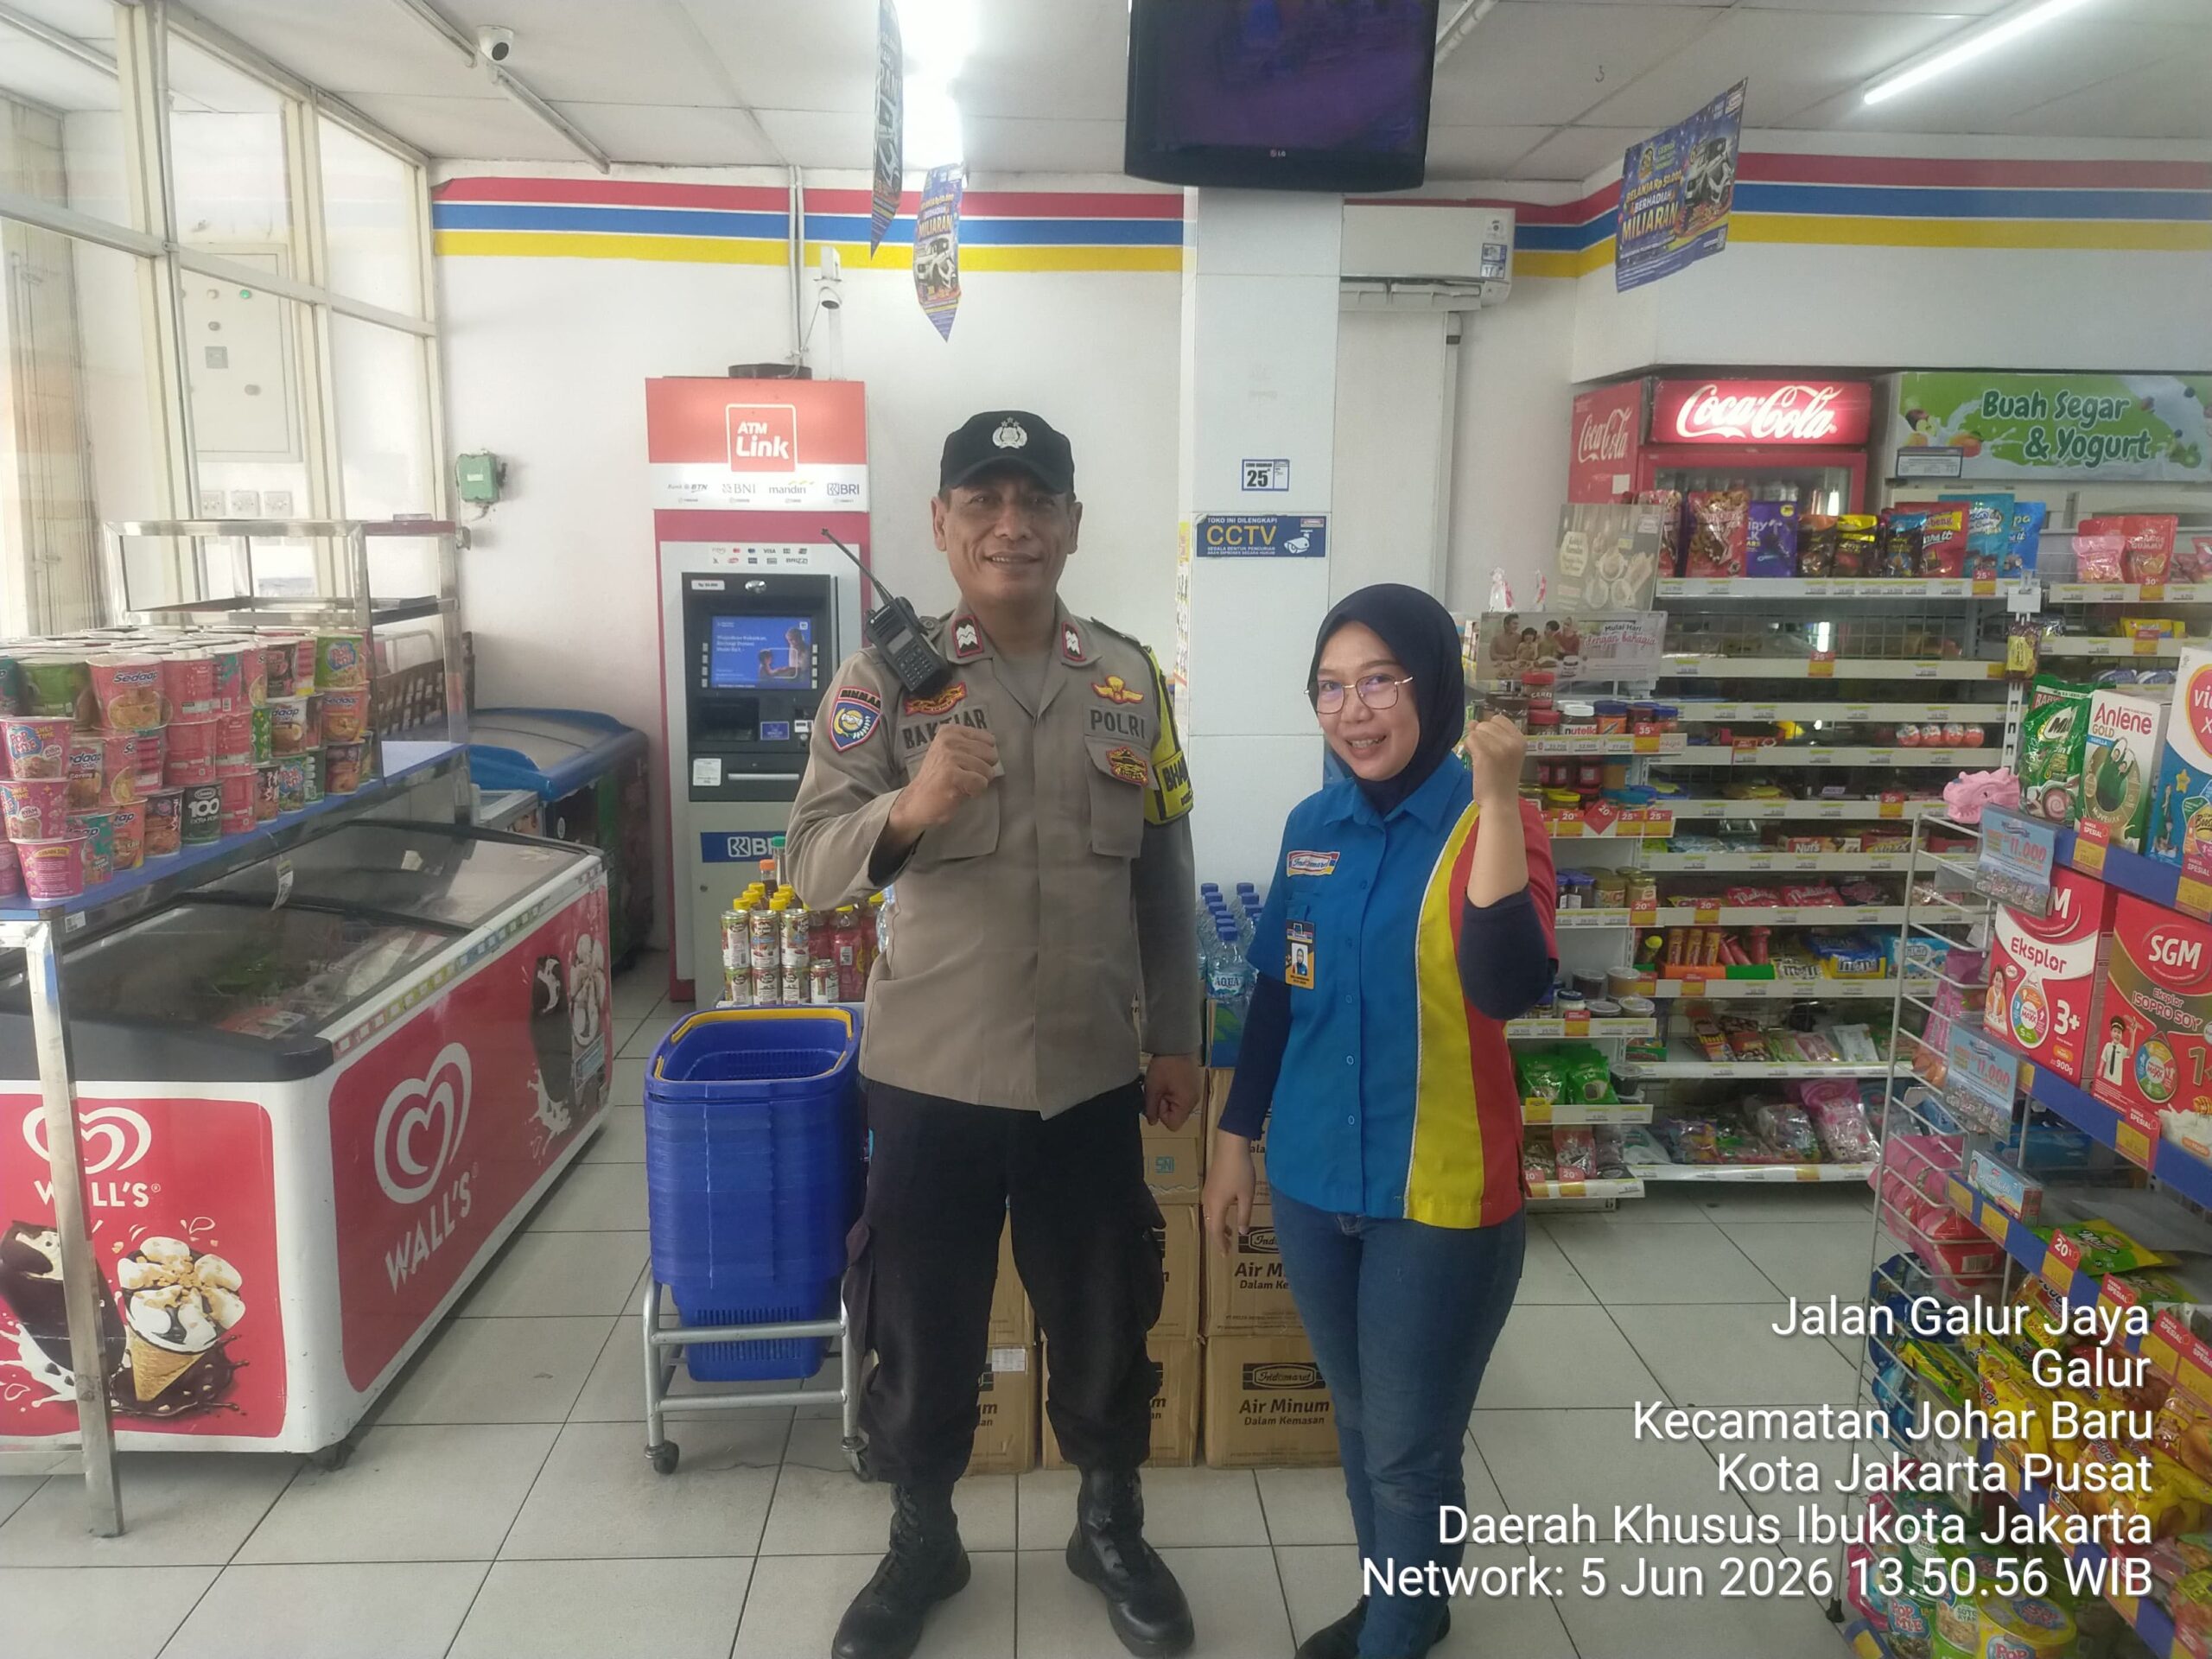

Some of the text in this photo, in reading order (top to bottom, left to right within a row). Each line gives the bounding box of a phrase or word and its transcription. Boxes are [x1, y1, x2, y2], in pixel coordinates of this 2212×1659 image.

[1622, 203, 1680, 242] MILIARAN
[1676, 384, 1843, 439] Coca-Cola
[1983, 391, 2131, 429] Buah Segar
[737, 422, 768, 435] ATM
[1578, 407, 1632, 463] Coca-Cola
[736, 435, 789, 460] Link
[2025, 427, 2151, 467] & Yogurt
[734, 484, 756, 494] BNI
[768, 482, 806, 494] mandiri
[841, 484, 860, 495] BRI
[1206, 525, 1277, 546] CCTV
[1605, 623, 1642, 632] Mulai Hari
[113, 671, 159, 683] Sedaap
[1090, 709, 1145, 740] POLRI
[2094, 702, 2152, 734] Anlene
[2092, 723, 2115, 738] GOLD
[188, 798, 219, 817] 100
[2084, 826, 2102, 838] SPESIAL
[2187, 863, 2210, 877] SPESIAL
[2011, 937, 2067, 974] Eksplor
[2148, 934, 2202, 969] SGM
[1214, 976, 1240, 988] AQUA
[2152, 987, 2184, 1008] Eksplor
[2054, 999, 2081, 1035] 3+
[2132, 990, 2203, 1032] ISOPRO SOY
[2056, 1058, 2074, 1077] 900g
[2130, 1113, 2152, 1130] SPESIAL
[34, 1179, 149, 1207] WLL'S
[385, 1172, 472, 1294] WALL'S
[1234, 1262, 1263, 1277] Air
[1239, 1281, 1273, 1289] Dalam
[2107, 1284, 2128, 1304] SPESIAL
[2160, 1320, 2184, 1344] SPESIAL
[1239, 1398, 1330, 1414] Air Minum
[1244, 1416, 1325, 1426] Dalam Kemasan
[1892, 1598, 1915, 1617] POP
[1895, 1616, 1923, 1633] MIE
